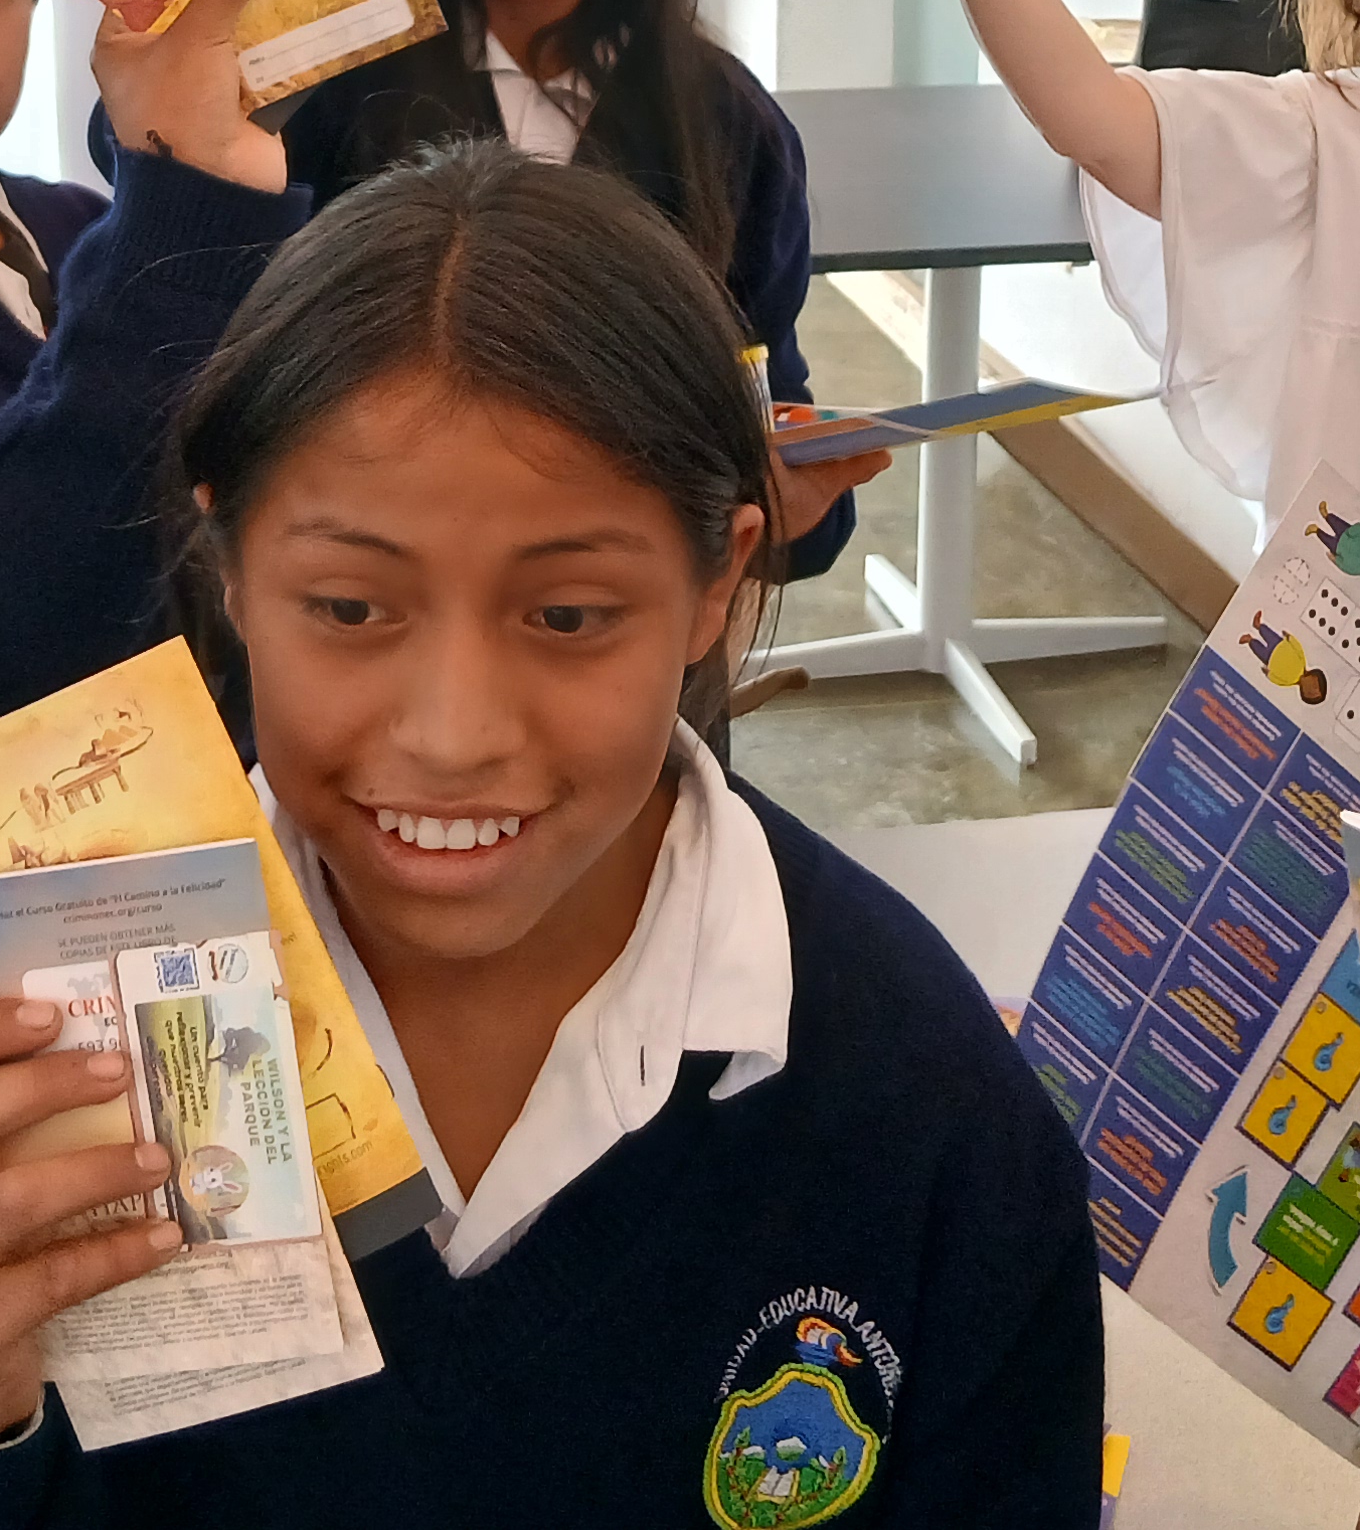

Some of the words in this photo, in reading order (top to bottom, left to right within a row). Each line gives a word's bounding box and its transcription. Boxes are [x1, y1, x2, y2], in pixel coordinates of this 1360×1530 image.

[267, 1057, 287, 1121] WILSON
[241, 1081, 260, 1147] PARQUE
[278, 1126, 289, 1136] Y
[264, 1135, 278, 1165] DEL
[280, 1143, 293, 1162] LA
